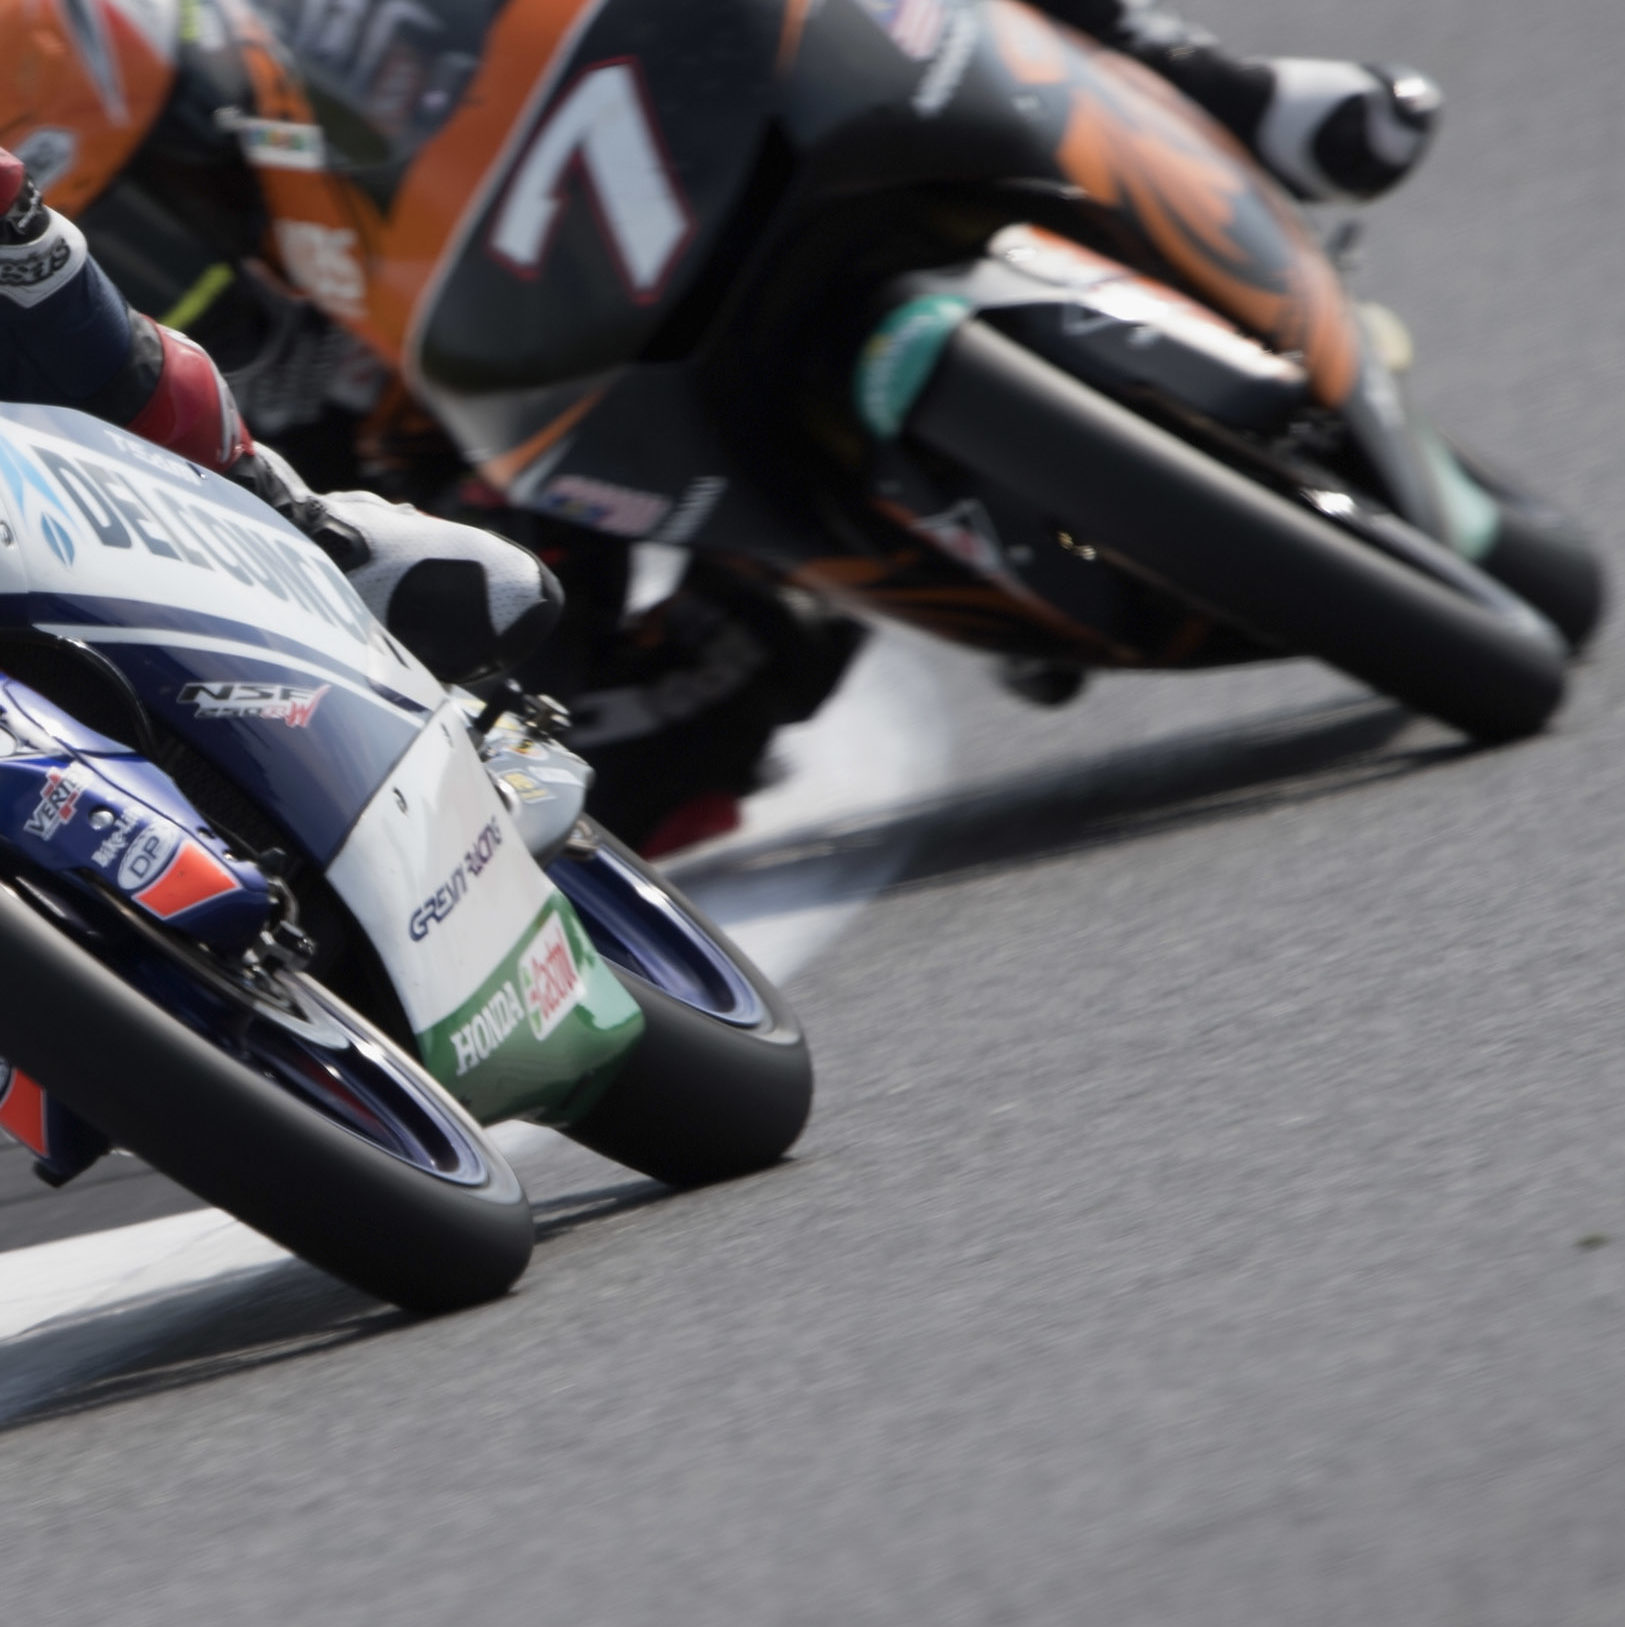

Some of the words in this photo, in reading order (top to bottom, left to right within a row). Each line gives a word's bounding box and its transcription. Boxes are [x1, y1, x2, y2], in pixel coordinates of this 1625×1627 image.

[490, 58, 694, 304] 7
[128, 835, 161, 879] DP
[450, 980, 526, 1077] HONDA
